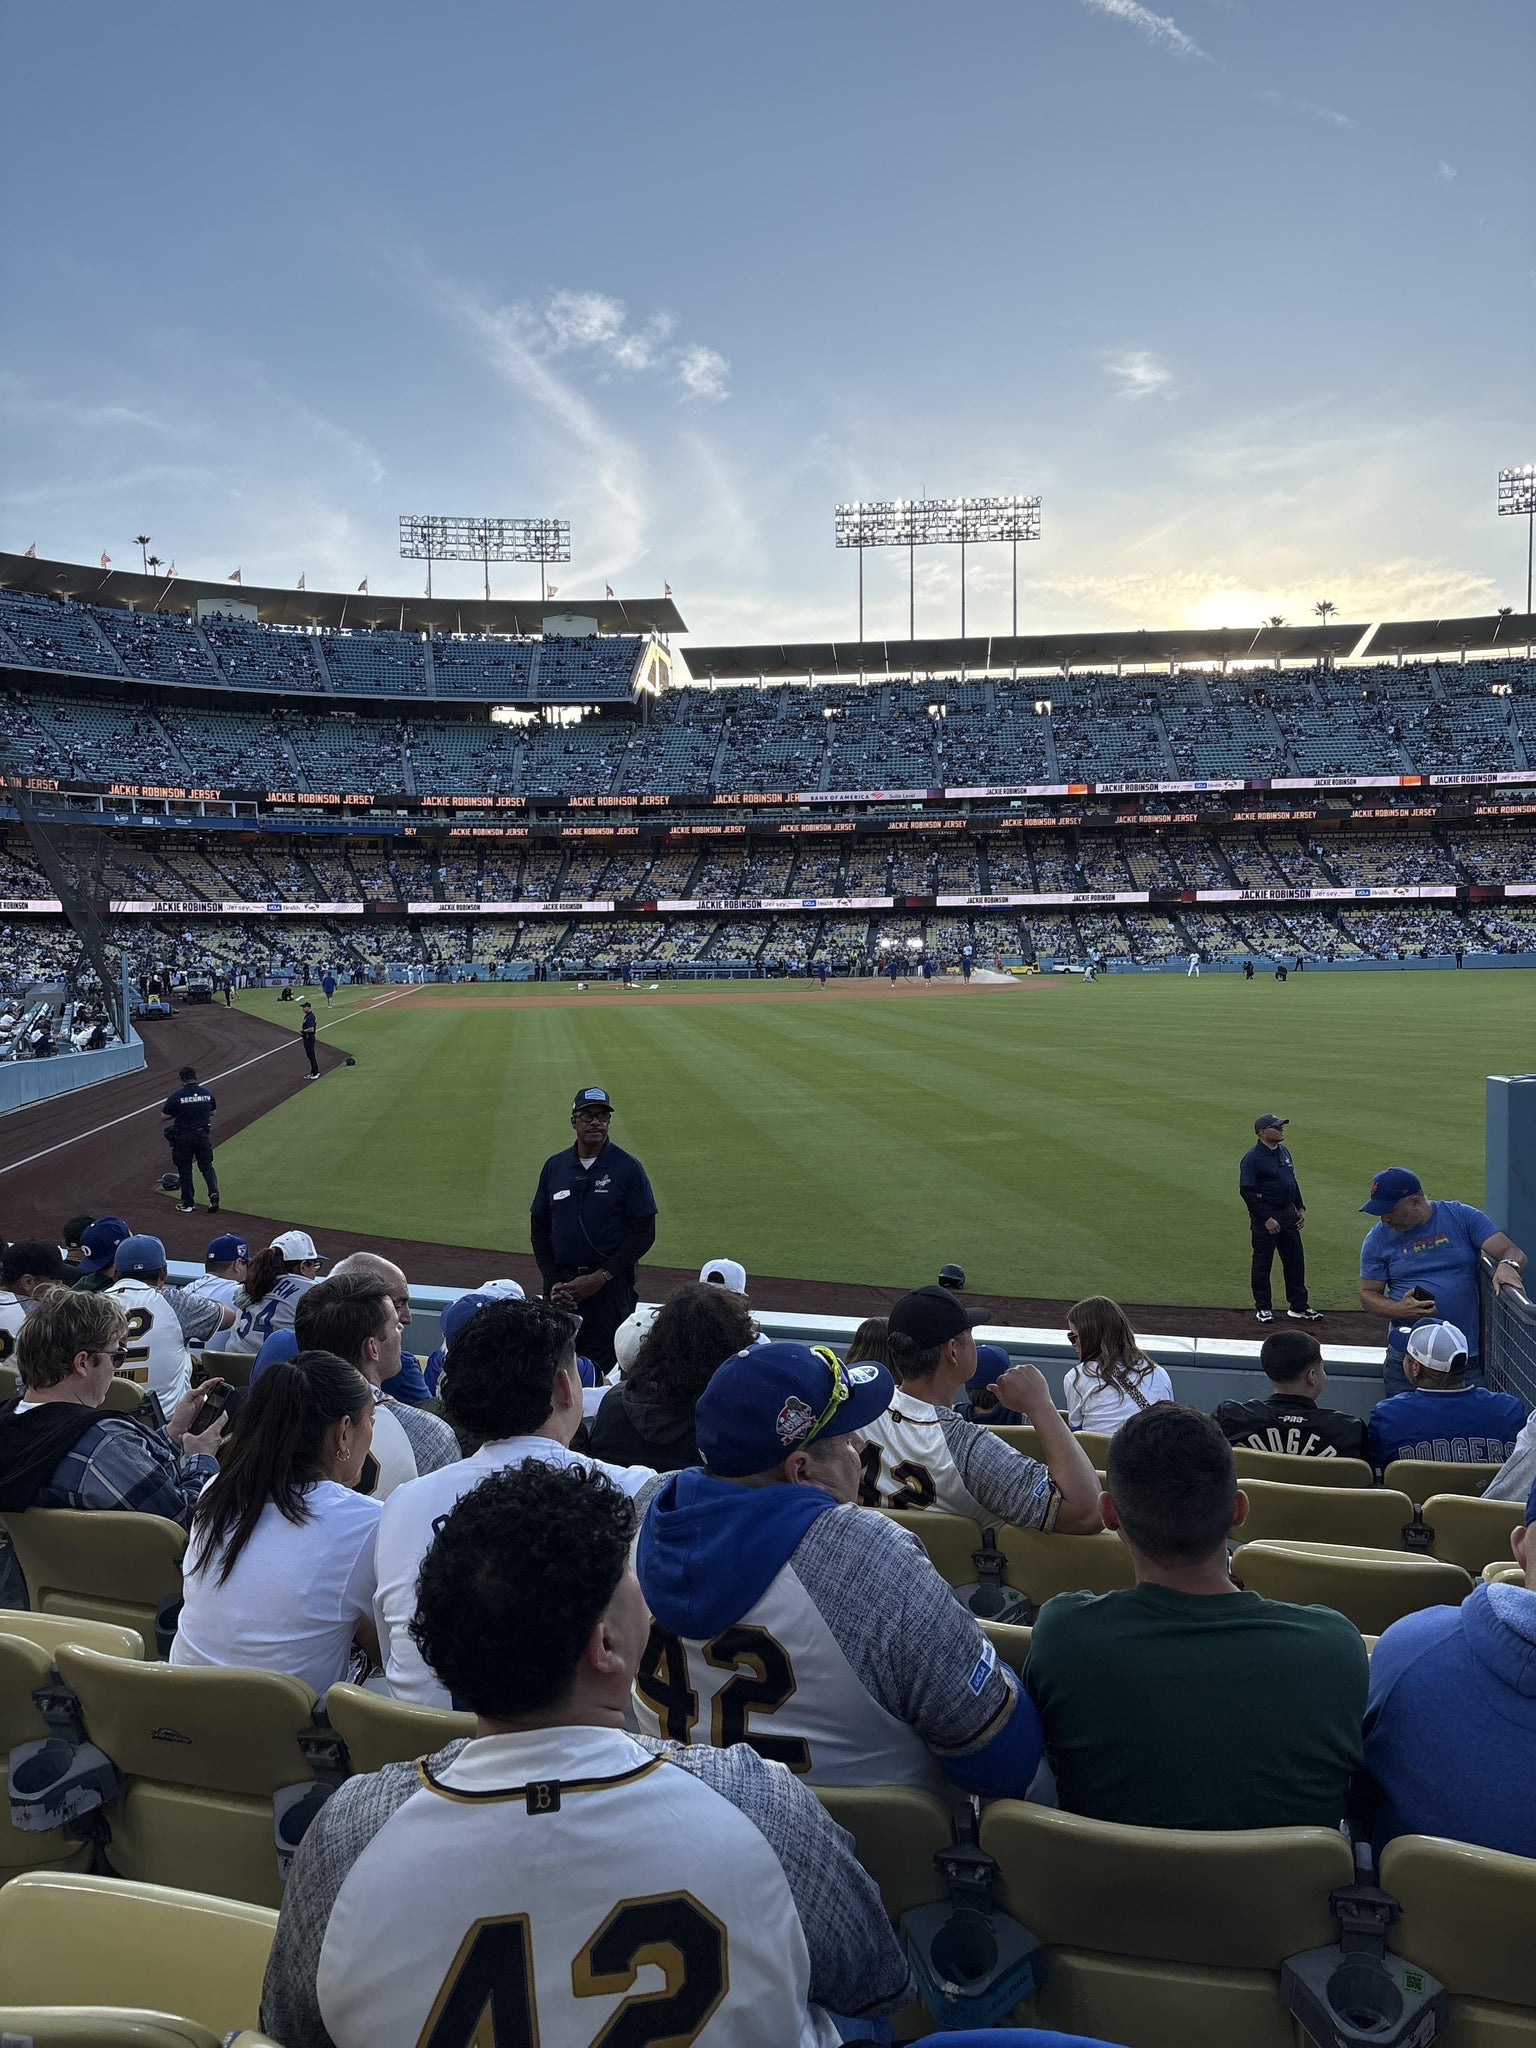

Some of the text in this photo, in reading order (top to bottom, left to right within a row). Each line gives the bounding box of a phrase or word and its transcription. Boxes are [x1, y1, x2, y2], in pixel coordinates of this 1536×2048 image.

[26, 778, 59, 790] JERSEY
[1435, 776, 1460, 784] JACKIE
[1461, 774, 1497, 782] ROBINSON
[108, 784, 221, 800] JACKIE ROBINSON JERSEY
[1125, 784, 1158, 792] ROBINSON
[266, 793, 375, 805] JACKIE ROBINSON JERSEY
[421, 796, 526, 807] JACKIE ROBINSON JERSEY
[568, 796, 669, 806] JACKIE ROBINSON JERSEY
[713, 794, 741, 804] JACKIE
[743, 794, 782, 803] ROBINSON
[1351, 808, 1436, 817] JACKIE ROBINSON JERSEY
[1474, 805, 1536, 815] JACKIE ROBINSON
[1173, 814, 1198, 822] JERSEY
[1233, 811, 1317, 820] JACKIE ROBINSON JERSEY
[1240, 890, 1268, 899] JACKIE
[1270, 890, 1310, 898] ROBINSON
[152, 902, 182, 911] JACKIE
[183, 902, 223, 911] ROBINSON
[697, 901, 722, 909] JACKIE
[724, 900, 762, 909] ROBINSON
[180, 1095, 211, 1104] SECURITY
[974, 1666, 986, 1686] UCLA
[633, 1616, 812, 1774] 42
[534, 1784, 550, 1810] B
[414, 1889, 730, 2048] 42
